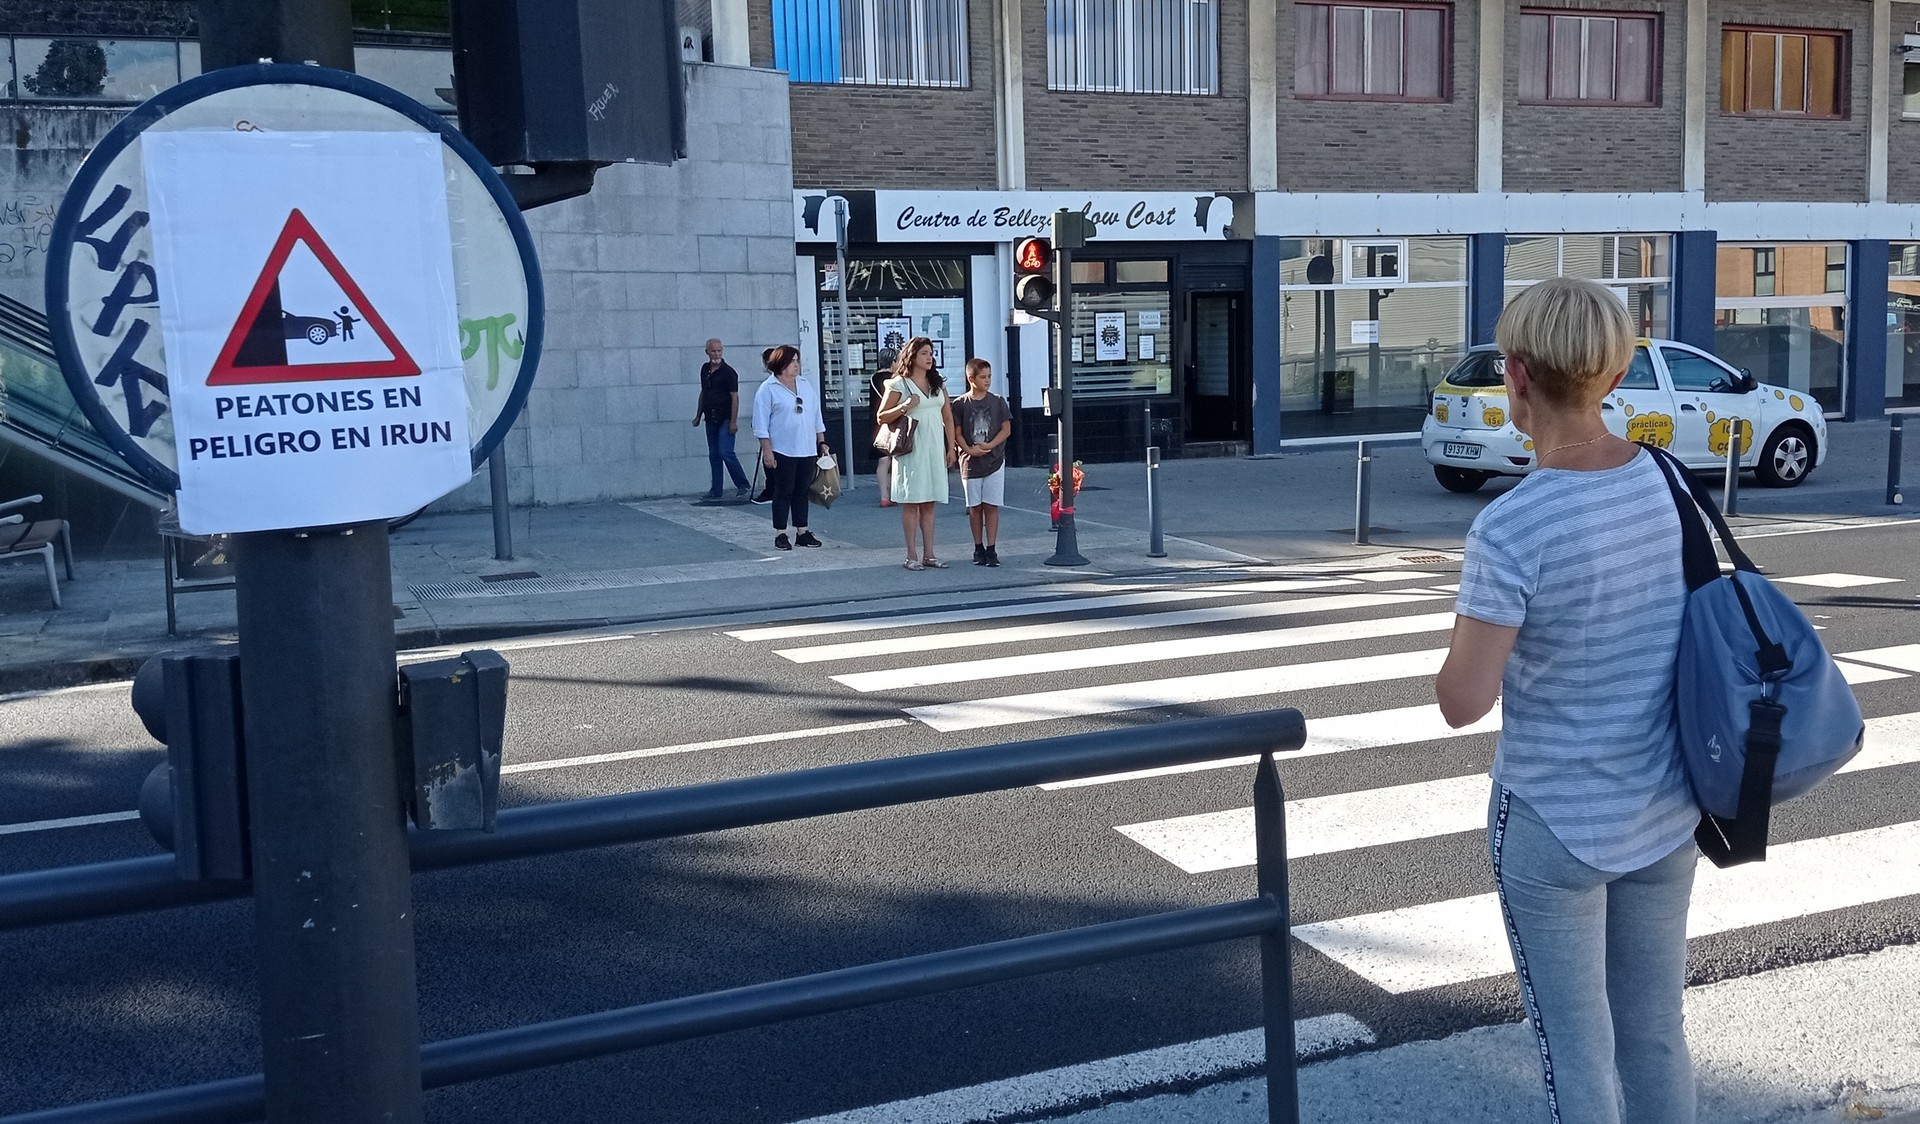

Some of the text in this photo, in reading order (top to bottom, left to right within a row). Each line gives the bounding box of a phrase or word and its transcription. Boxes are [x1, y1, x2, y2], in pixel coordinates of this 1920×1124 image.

[897, 206, 960, 230] Centro
[966, 208, 988, 228] de
[1125, 200, 1177, 230] Cost
[215, 386, 422, 420] PEATONES EN
[189, 421, 452, 461] PELIGRO EN IRUN
[1448, 444, 1465, 455] 9137
[1500, 784, 1511, 813] SPO
[1493, 820, 1505, 865] SPORT
[1524, 976, 1541, 1020] SPORT
[1537, 1028, 1552, 1073] SPORT
[1546, 1082, 1560, 1124] SPORT
